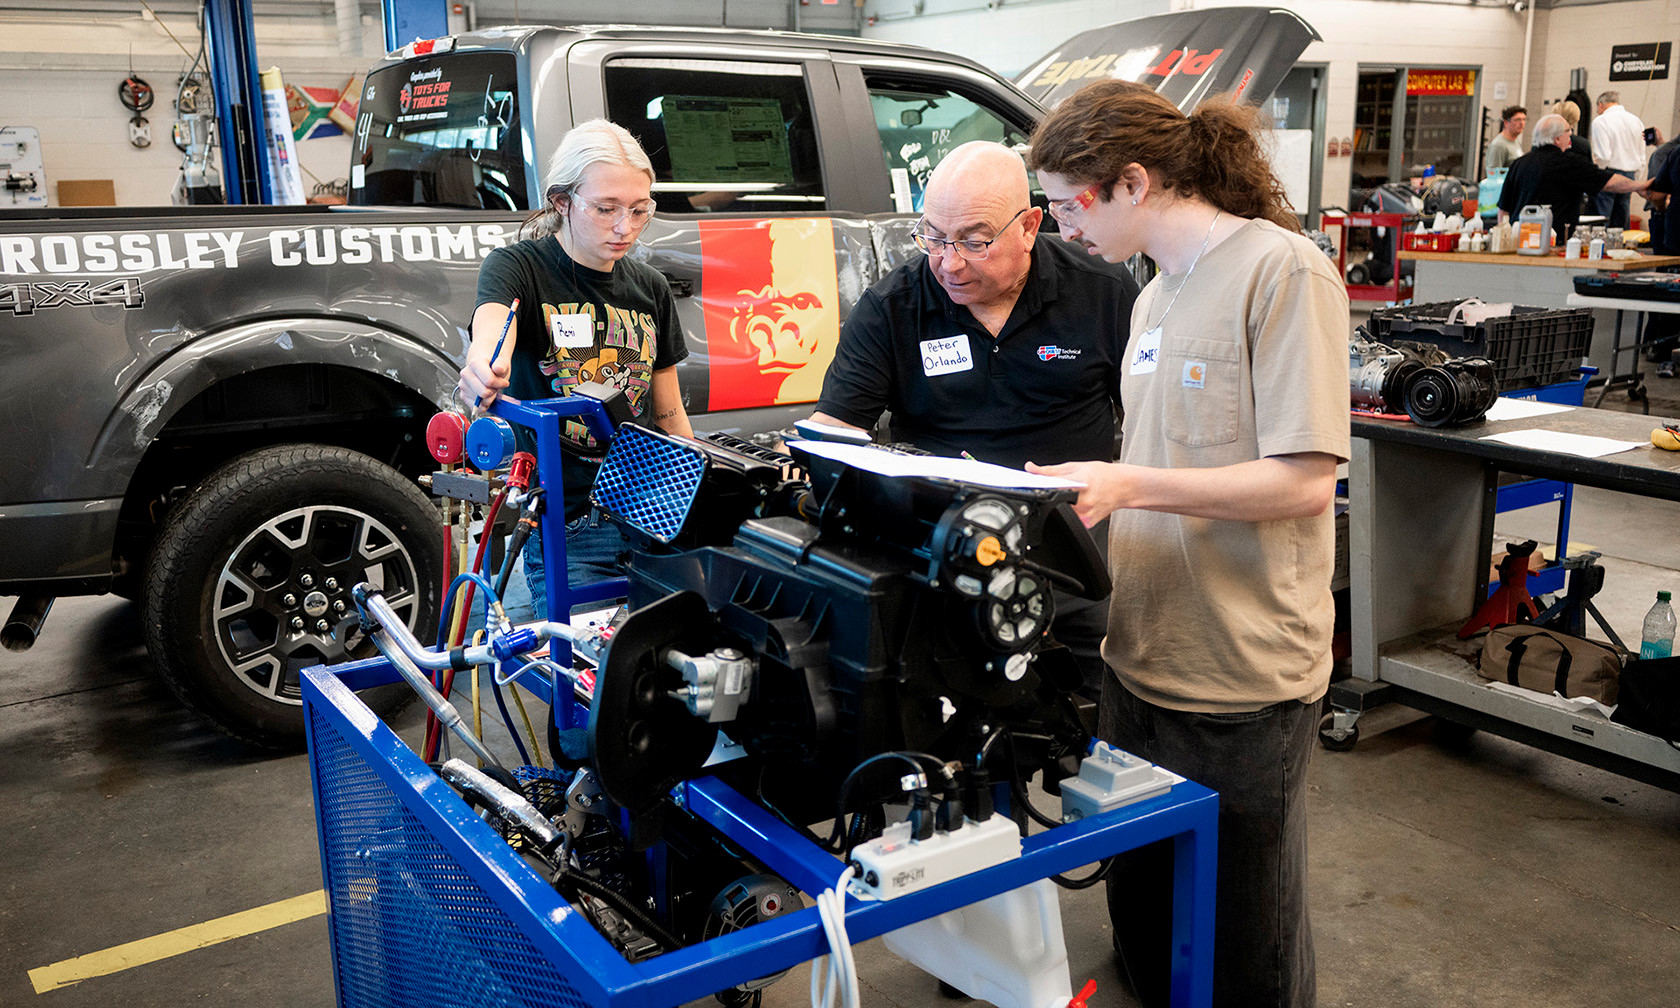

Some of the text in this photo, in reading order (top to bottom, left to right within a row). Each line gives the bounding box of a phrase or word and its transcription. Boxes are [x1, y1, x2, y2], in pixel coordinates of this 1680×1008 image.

[413, 81, 451, 96] TOYS FOR
[1448, 75, 1463, 90] LAB
[412, 94, 449, 109] TRUCKS
[269, 224, 507, 267] CUSTOMS
[927, 340, 958, 353] Peter
[924, 351, 967, 370] Orlando
[1133, 348, 1158, 366] JAMES
